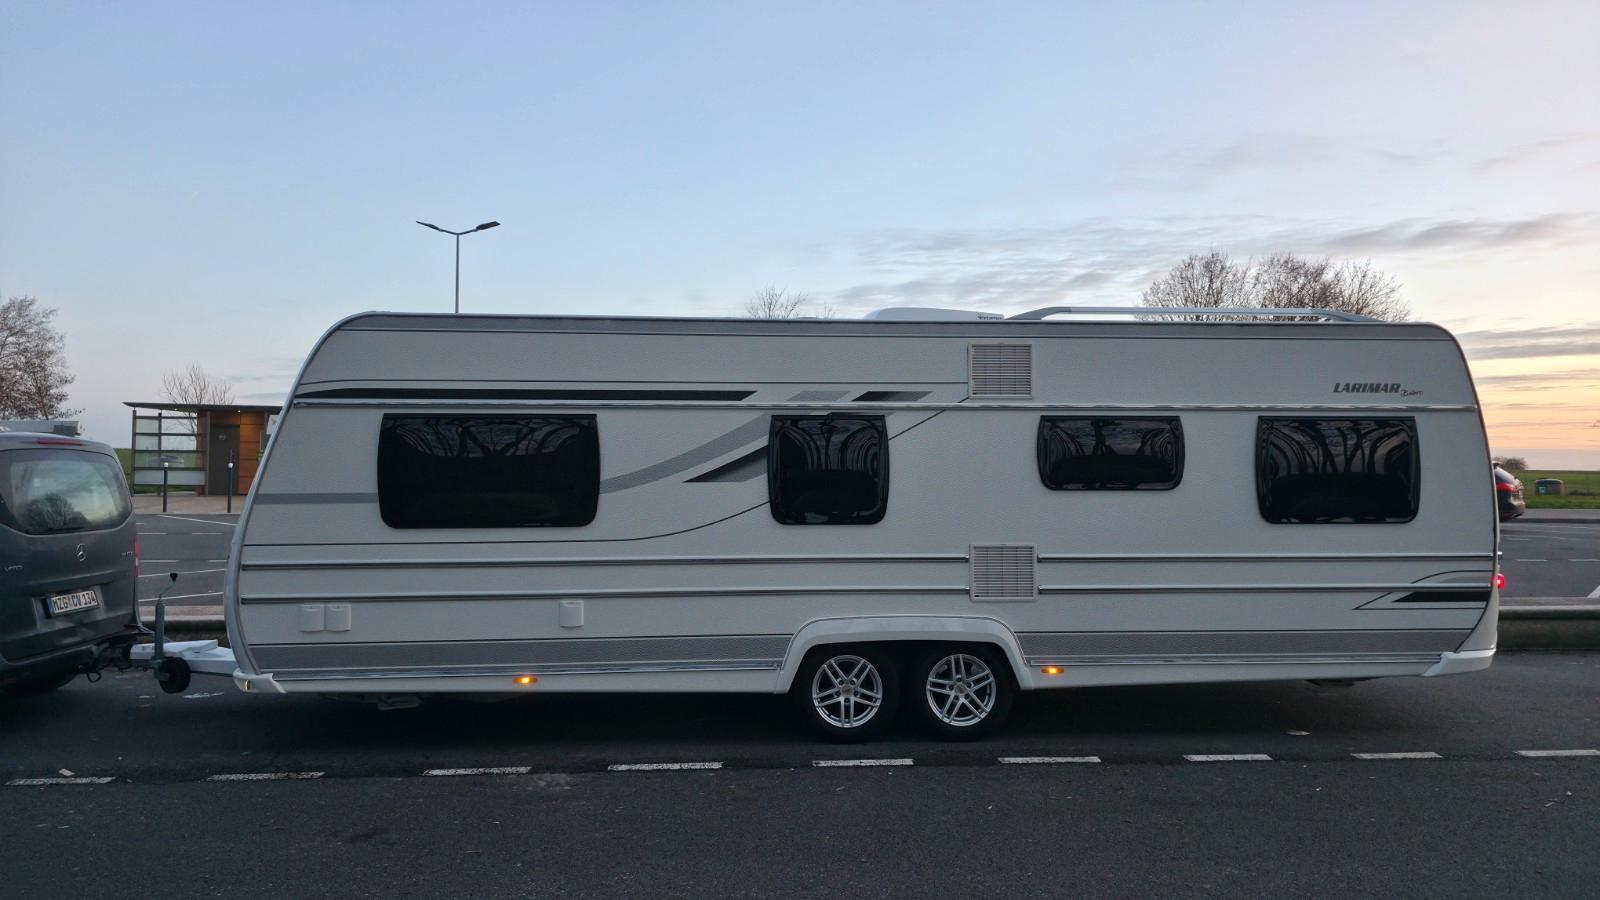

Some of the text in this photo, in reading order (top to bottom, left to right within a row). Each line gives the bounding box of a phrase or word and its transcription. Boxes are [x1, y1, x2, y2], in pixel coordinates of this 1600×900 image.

[1333, 383, 1401, 393] LARIMAR
[53, 597, 68, 611] MZG
[82, 591, 97, 605] 134
